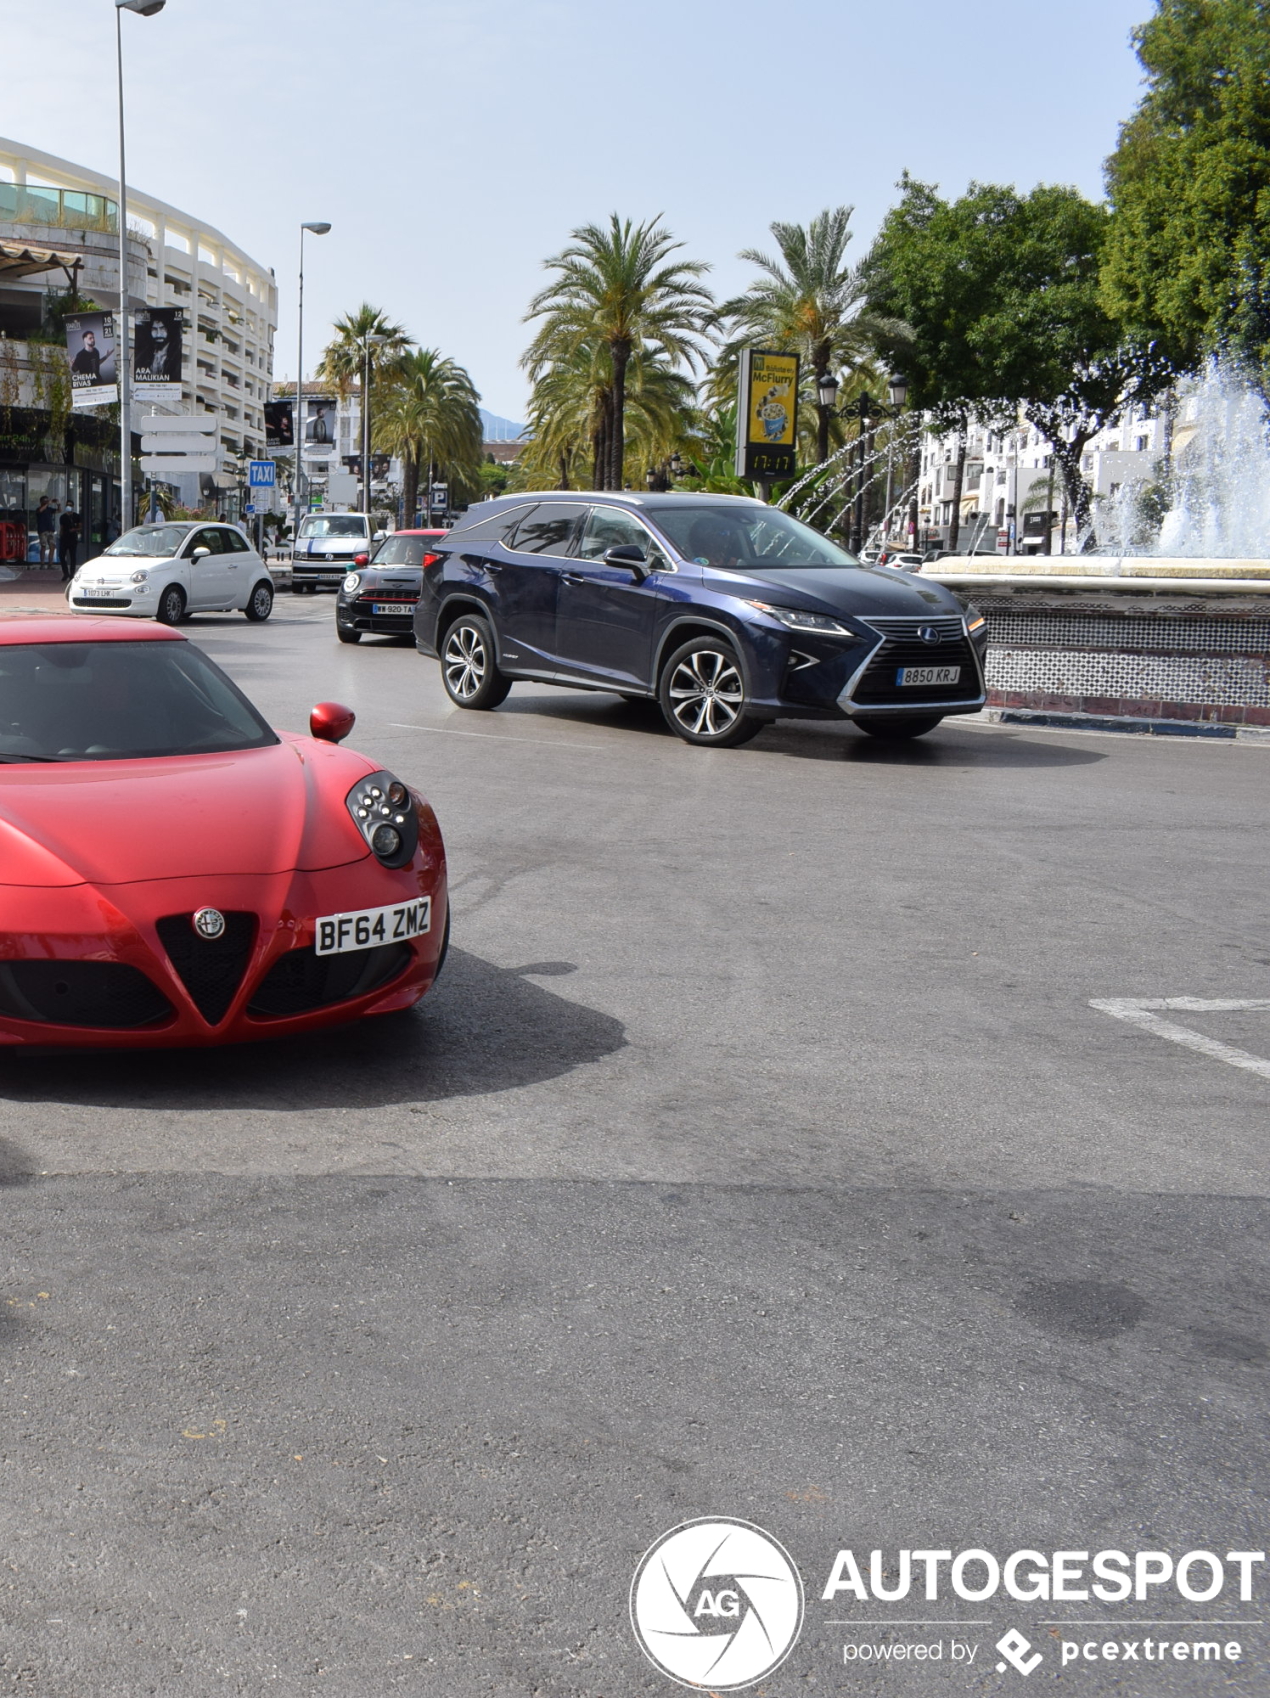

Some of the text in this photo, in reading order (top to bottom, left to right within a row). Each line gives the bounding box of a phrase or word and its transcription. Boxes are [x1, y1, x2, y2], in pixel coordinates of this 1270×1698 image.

[175, 310, 182, 318] 12
[72, 372, 97, 382] CHEMA
[72, 380, 92, 388] RIVAS
[753, 371, 794, 387] McFlurry
[754, 455, 789, 470] 17:17
[251, 465, 273, 483] TAXI
[434, 493, 445, 504] P
[905, 668, 959, 683] 8850 KRJ
[319, 901, 429, 951] BF64 ZMZ
